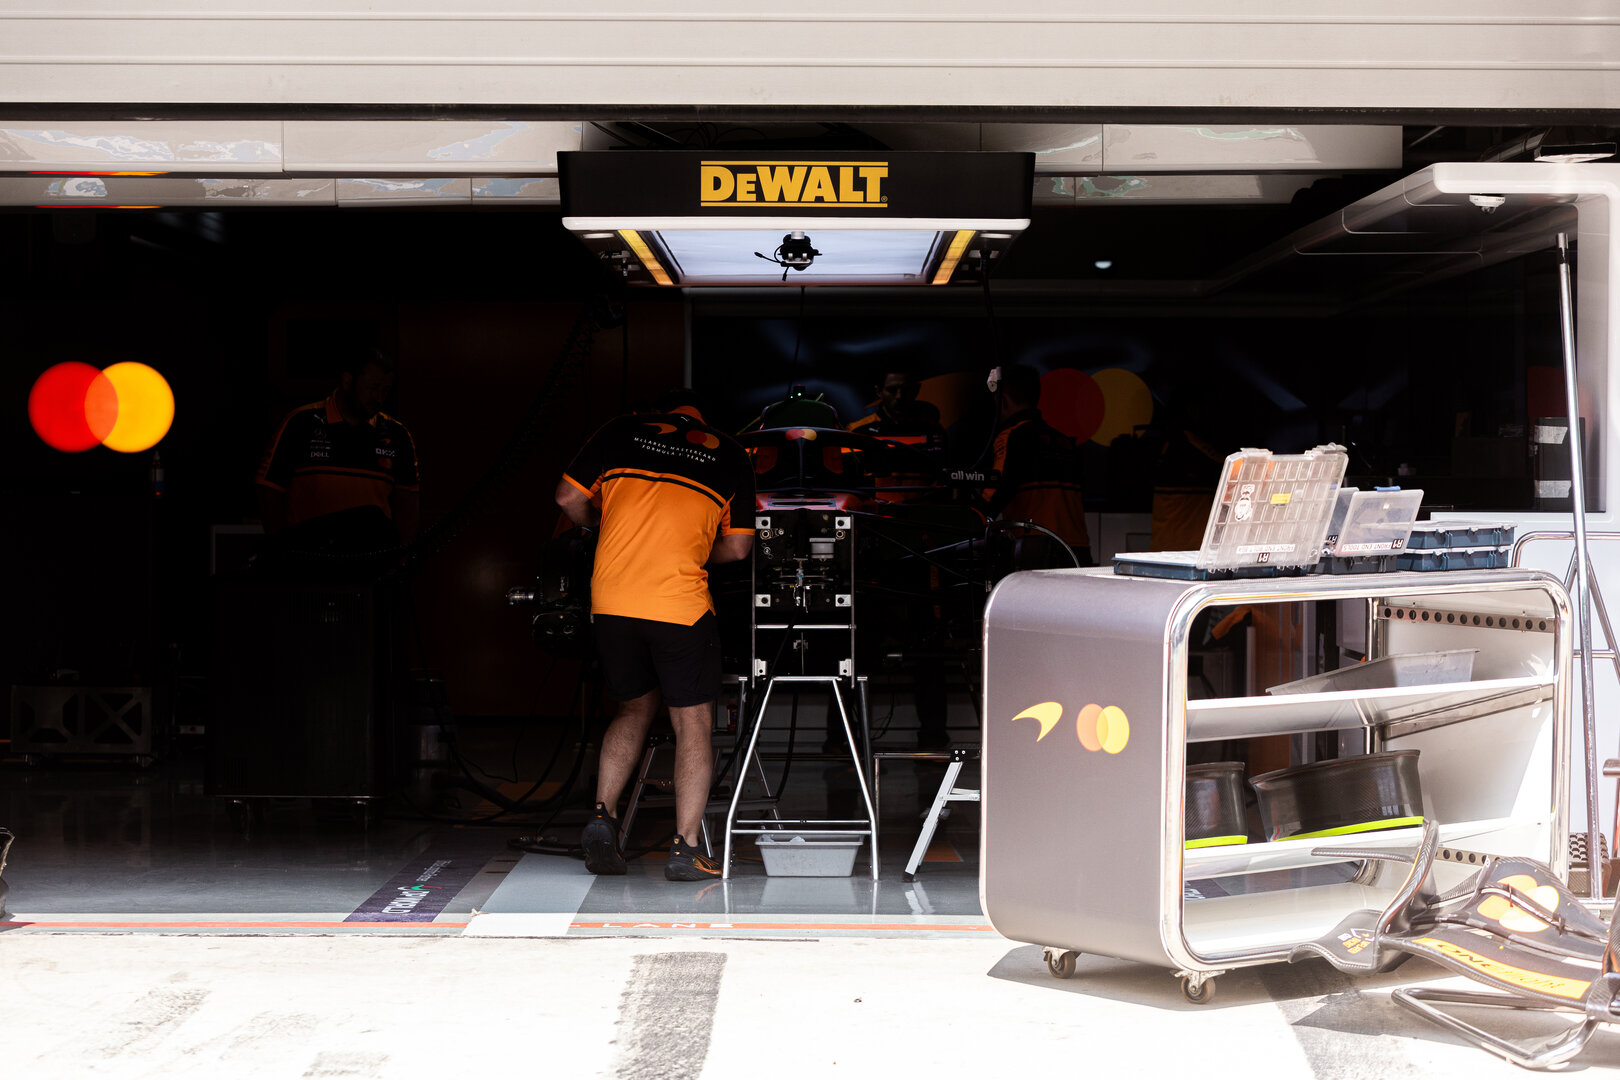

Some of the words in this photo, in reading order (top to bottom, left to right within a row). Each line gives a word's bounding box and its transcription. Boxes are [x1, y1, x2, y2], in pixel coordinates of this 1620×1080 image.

[310, 450, 330, 458] DELL
[641, 444, 675, 456] FORMULA
[686, 454, 705, 463] TEAM
[670, 446, 717, 462] MASTERCARD
[1391, 539, 1404, 549] R1
[1257, 553, 1270, 562] R1
